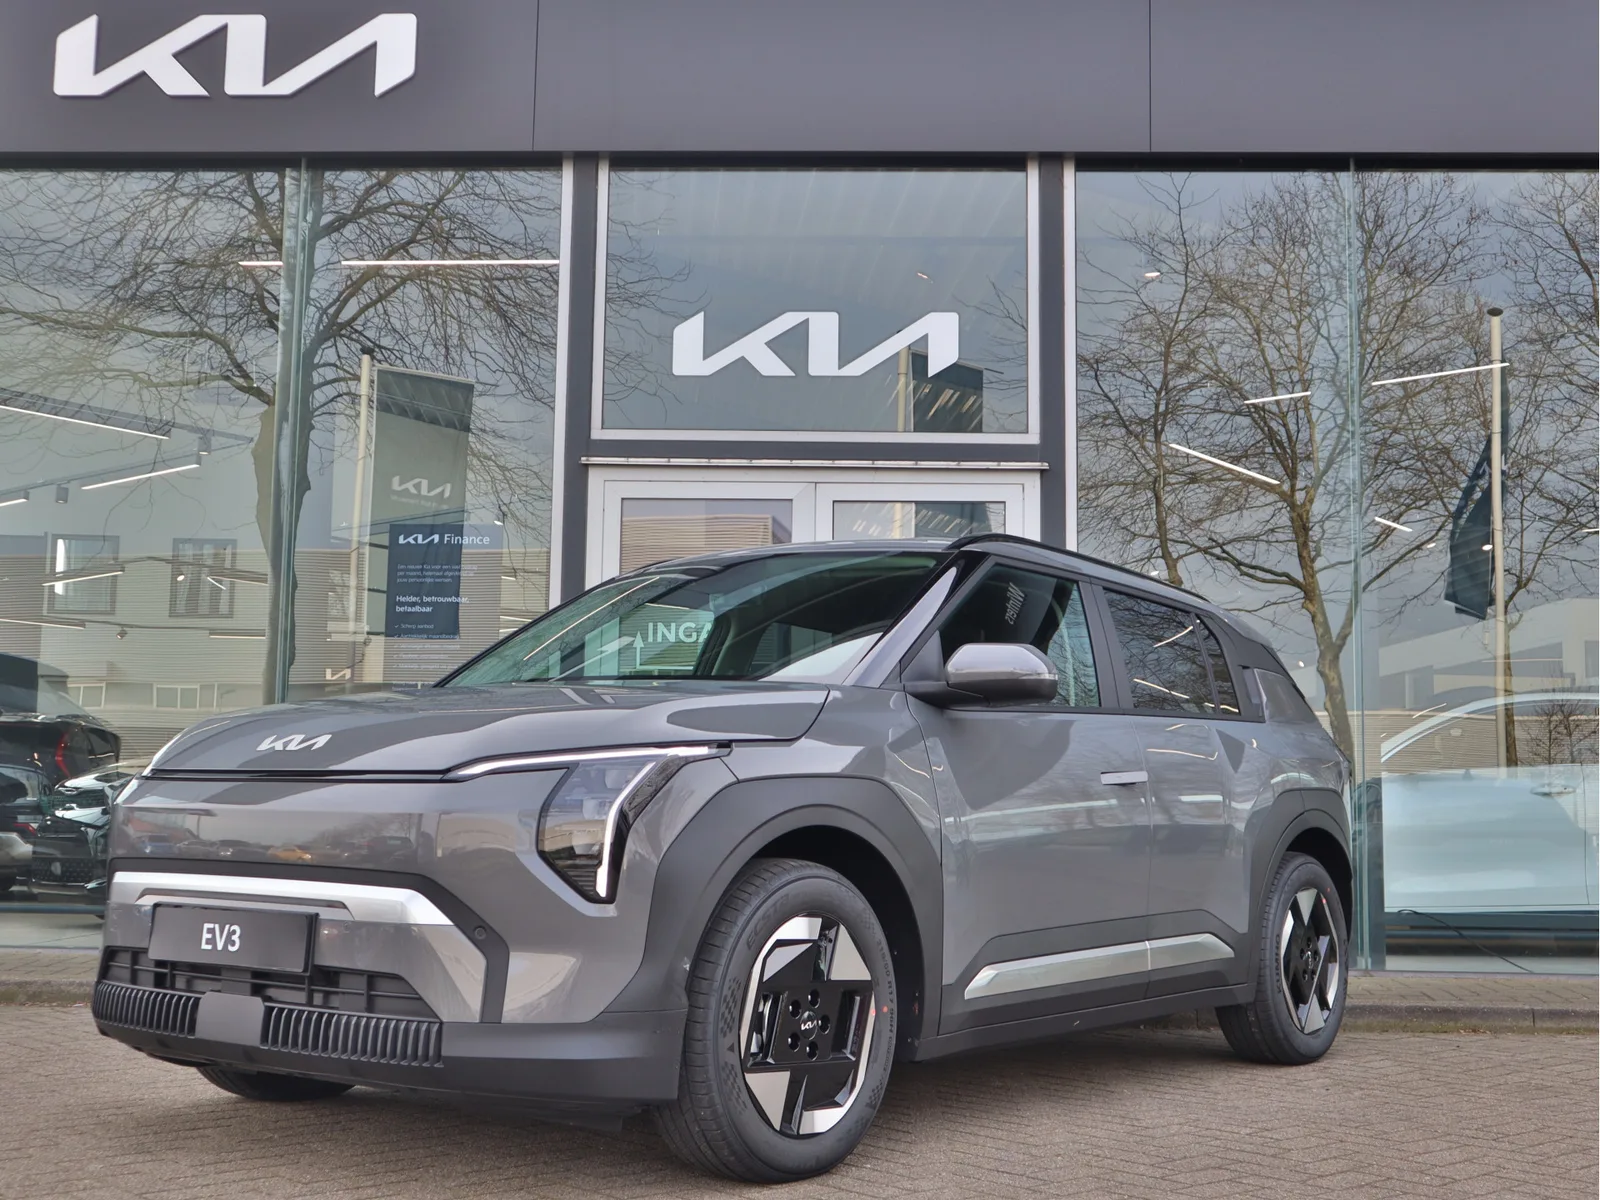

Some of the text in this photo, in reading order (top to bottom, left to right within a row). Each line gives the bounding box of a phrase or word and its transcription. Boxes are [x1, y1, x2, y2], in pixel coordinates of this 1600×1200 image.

[53, 13, 417, 98] KIA
[672, 311, 959, 378] KIA
[391, 475, 451, 499] KIA
[398, 533, 490, 545] KIA Finance
[396, 595, 470, 604] Helder, betrouwbaar,
[396, 605, 433, 613] betaalbaar
[256, 733, 332, 751] KIA
[201, 922, 241, 952] EV3
